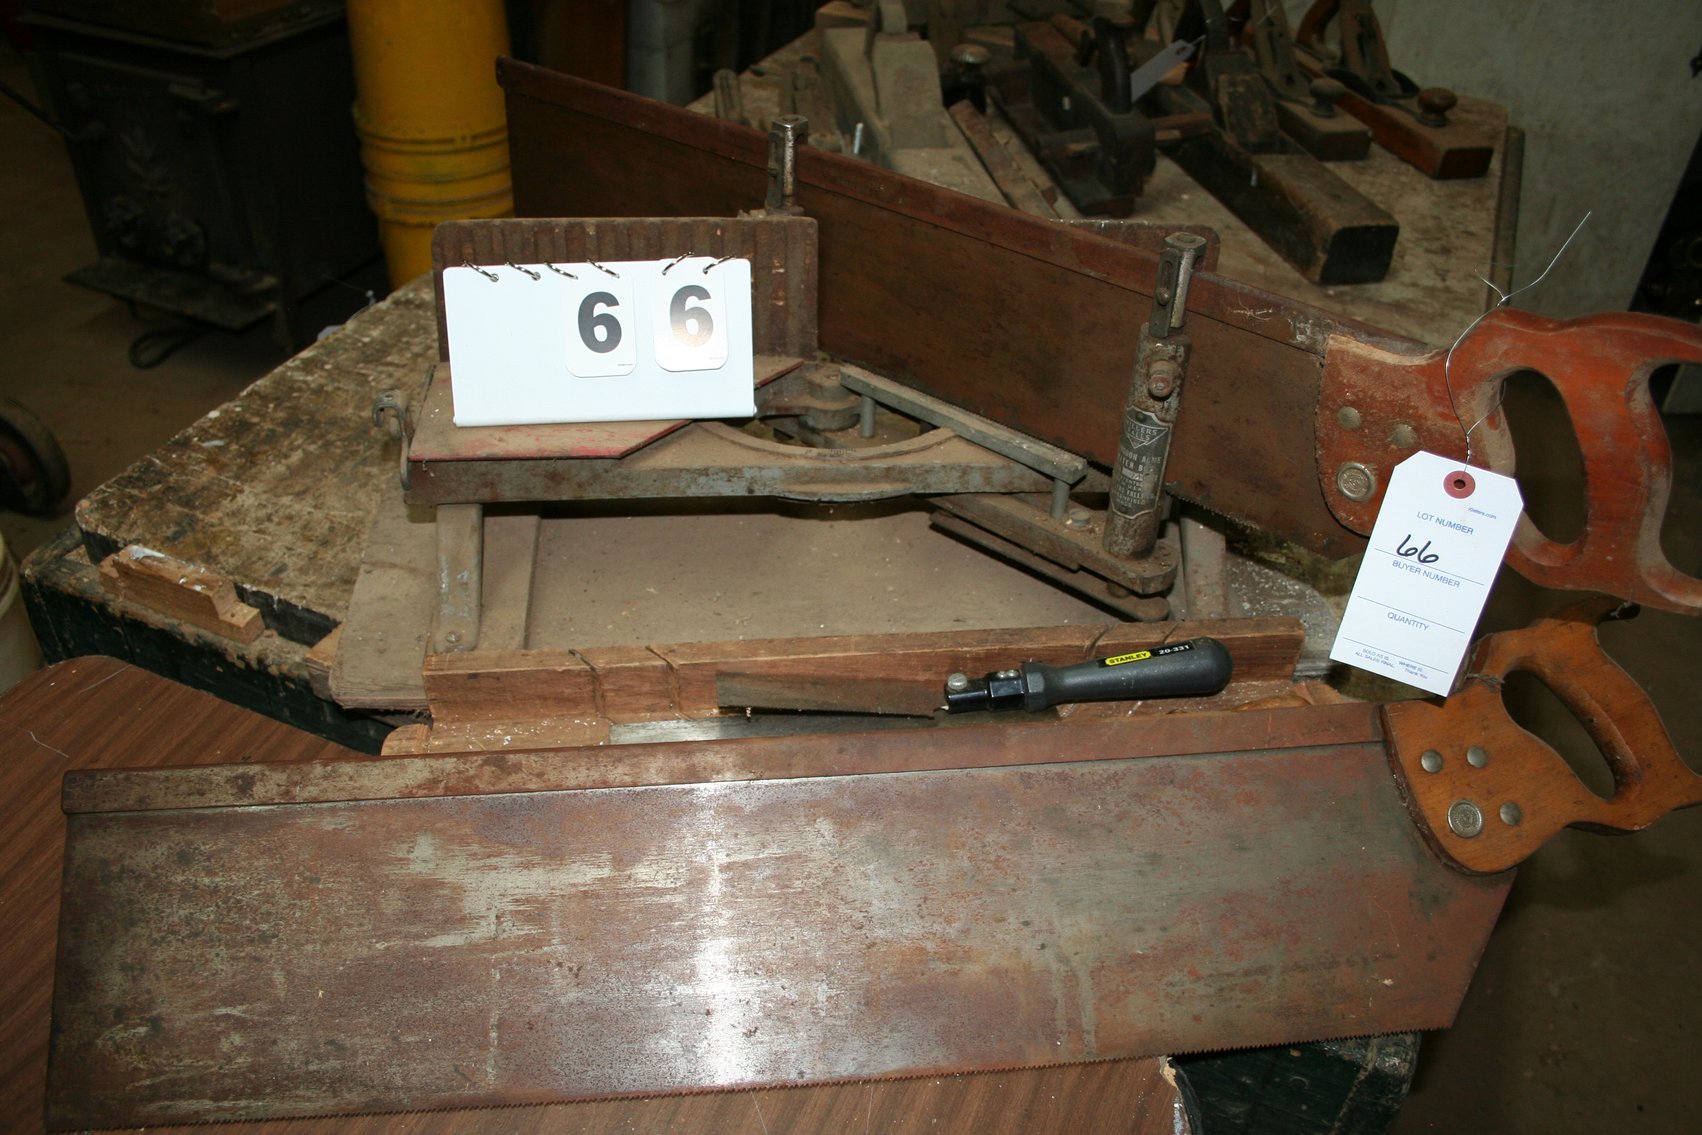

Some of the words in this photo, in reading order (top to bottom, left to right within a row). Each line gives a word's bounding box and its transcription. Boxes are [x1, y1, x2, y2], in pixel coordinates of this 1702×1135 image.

[577, 291, 622, 353] 6
[669, 284, 714, 347] 6
[1417, 511, 1435, 524] LOT
[1435, 517, 1474, 535] NUMBER
[1396, 534, 1439, 563] 66
[1392, 559, 1421, 575] BUYER
[1422, 570, 1461, 588] NUMBER
[1387, 611, 1430, 631] QUANTITY
[1109, 652, 1147, 664] STANLEY
[1159, 644, 1190, 655] 20-331
